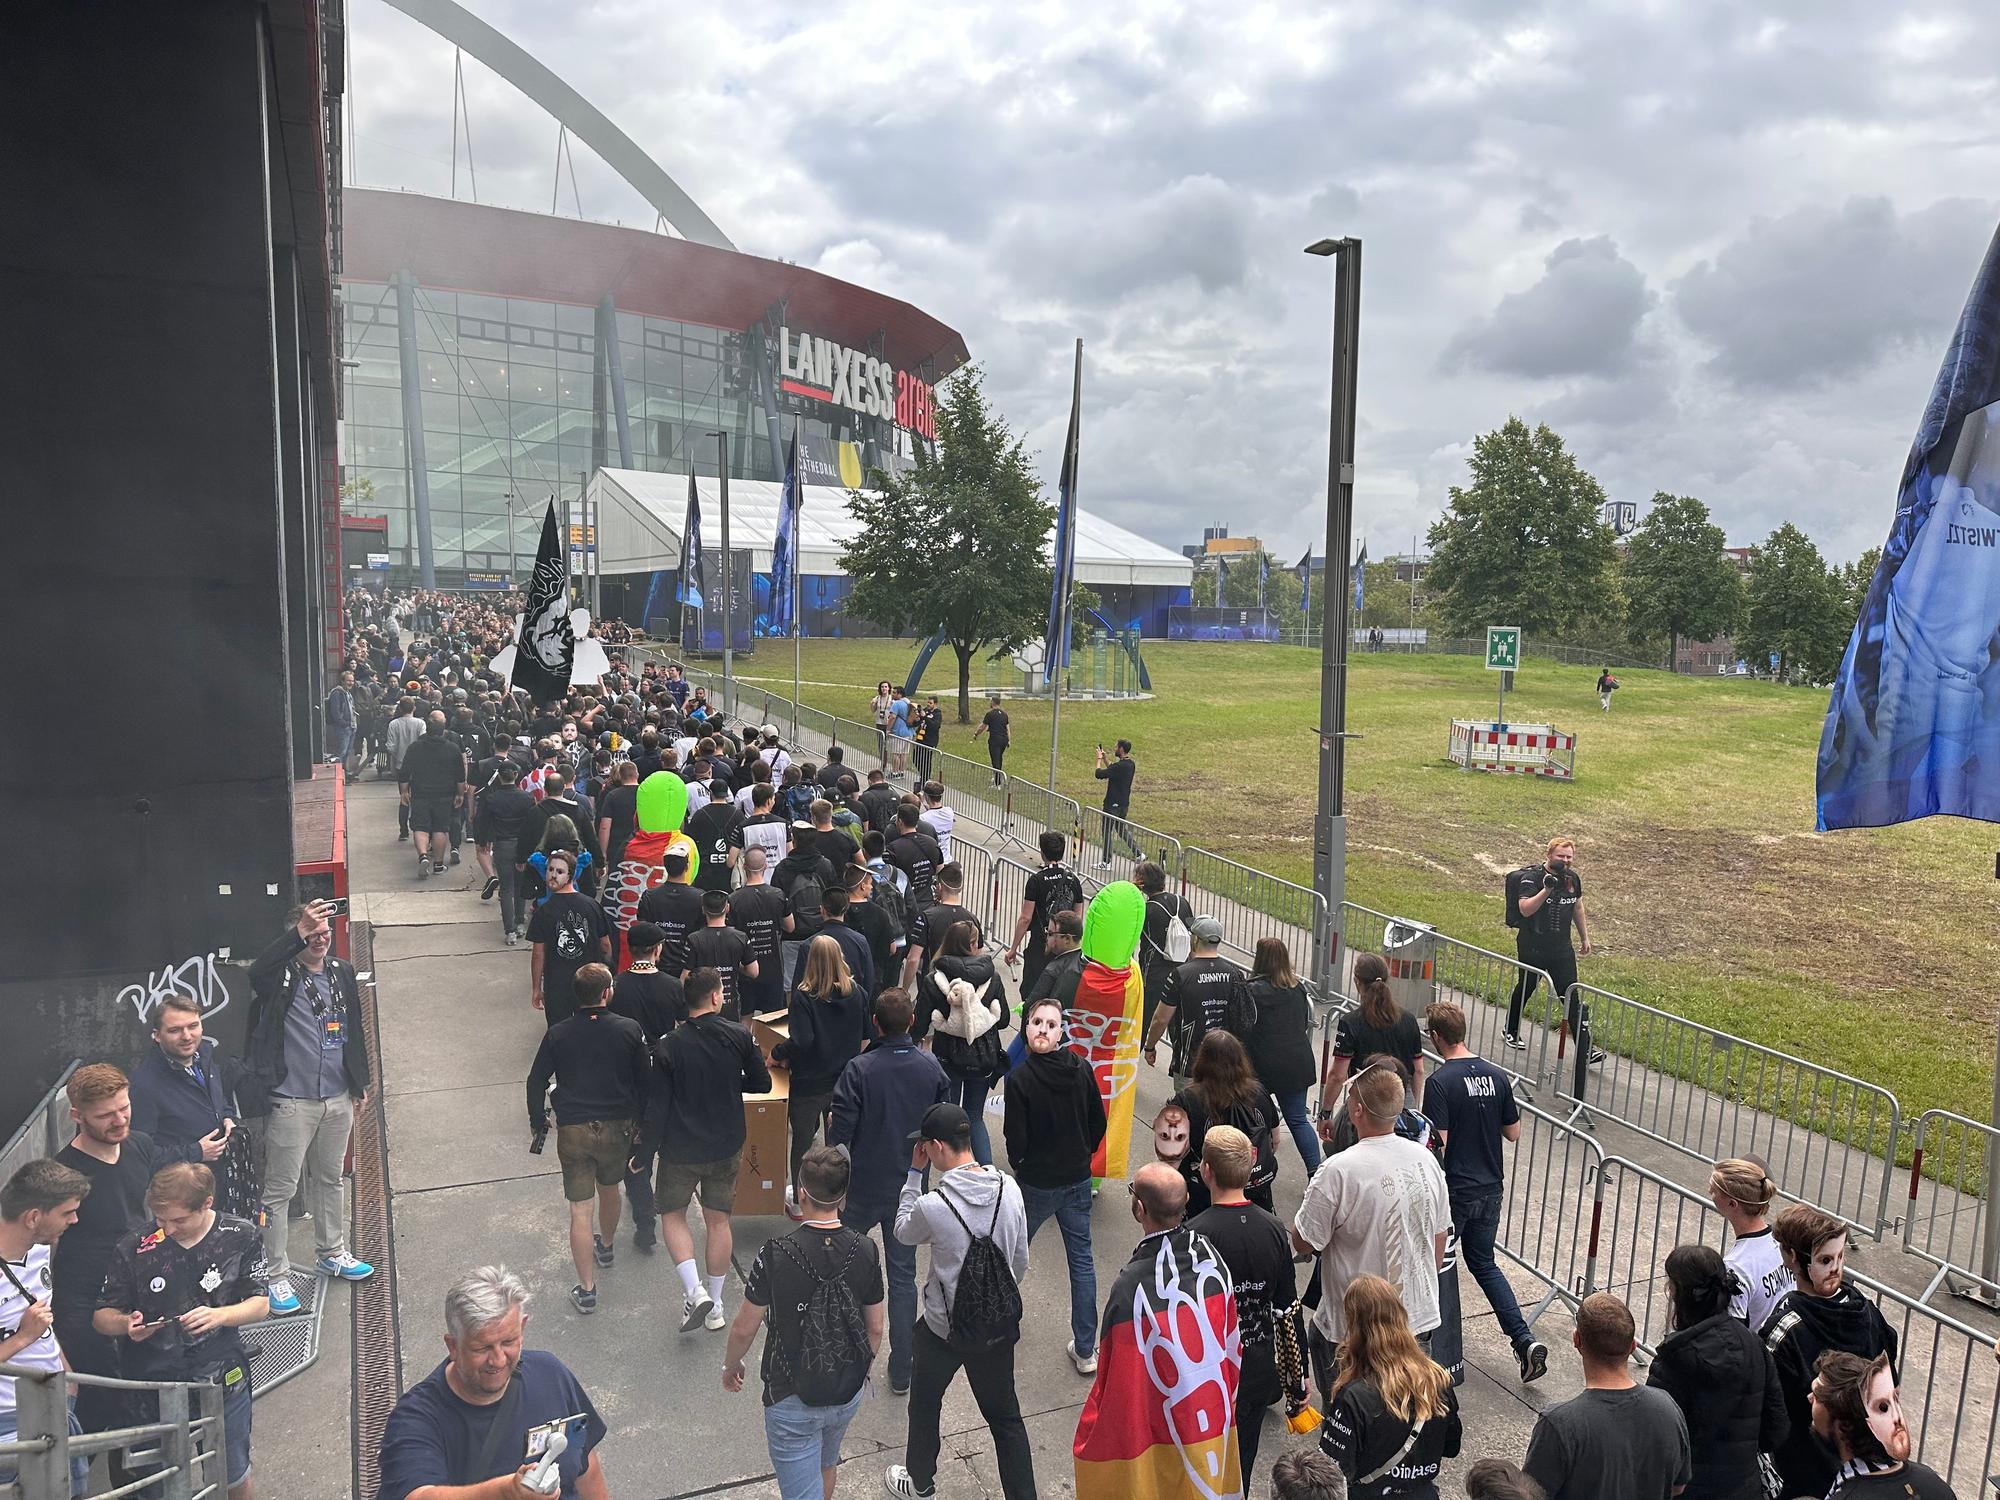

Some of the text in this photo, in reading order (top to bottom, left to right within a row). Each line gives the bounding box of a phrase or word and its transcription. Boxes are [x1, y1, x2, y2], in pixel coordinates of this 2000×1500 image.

[779, 326, 893, 421] LANXESS
[799, 444, 809, 458] HE
[710, 854, 729, 863] ES
[655, 920, 686, 929] coinbase
[747, 919, 774, 927] coinbase
[1197, 972, 1231, 984] JOHNNYYY
